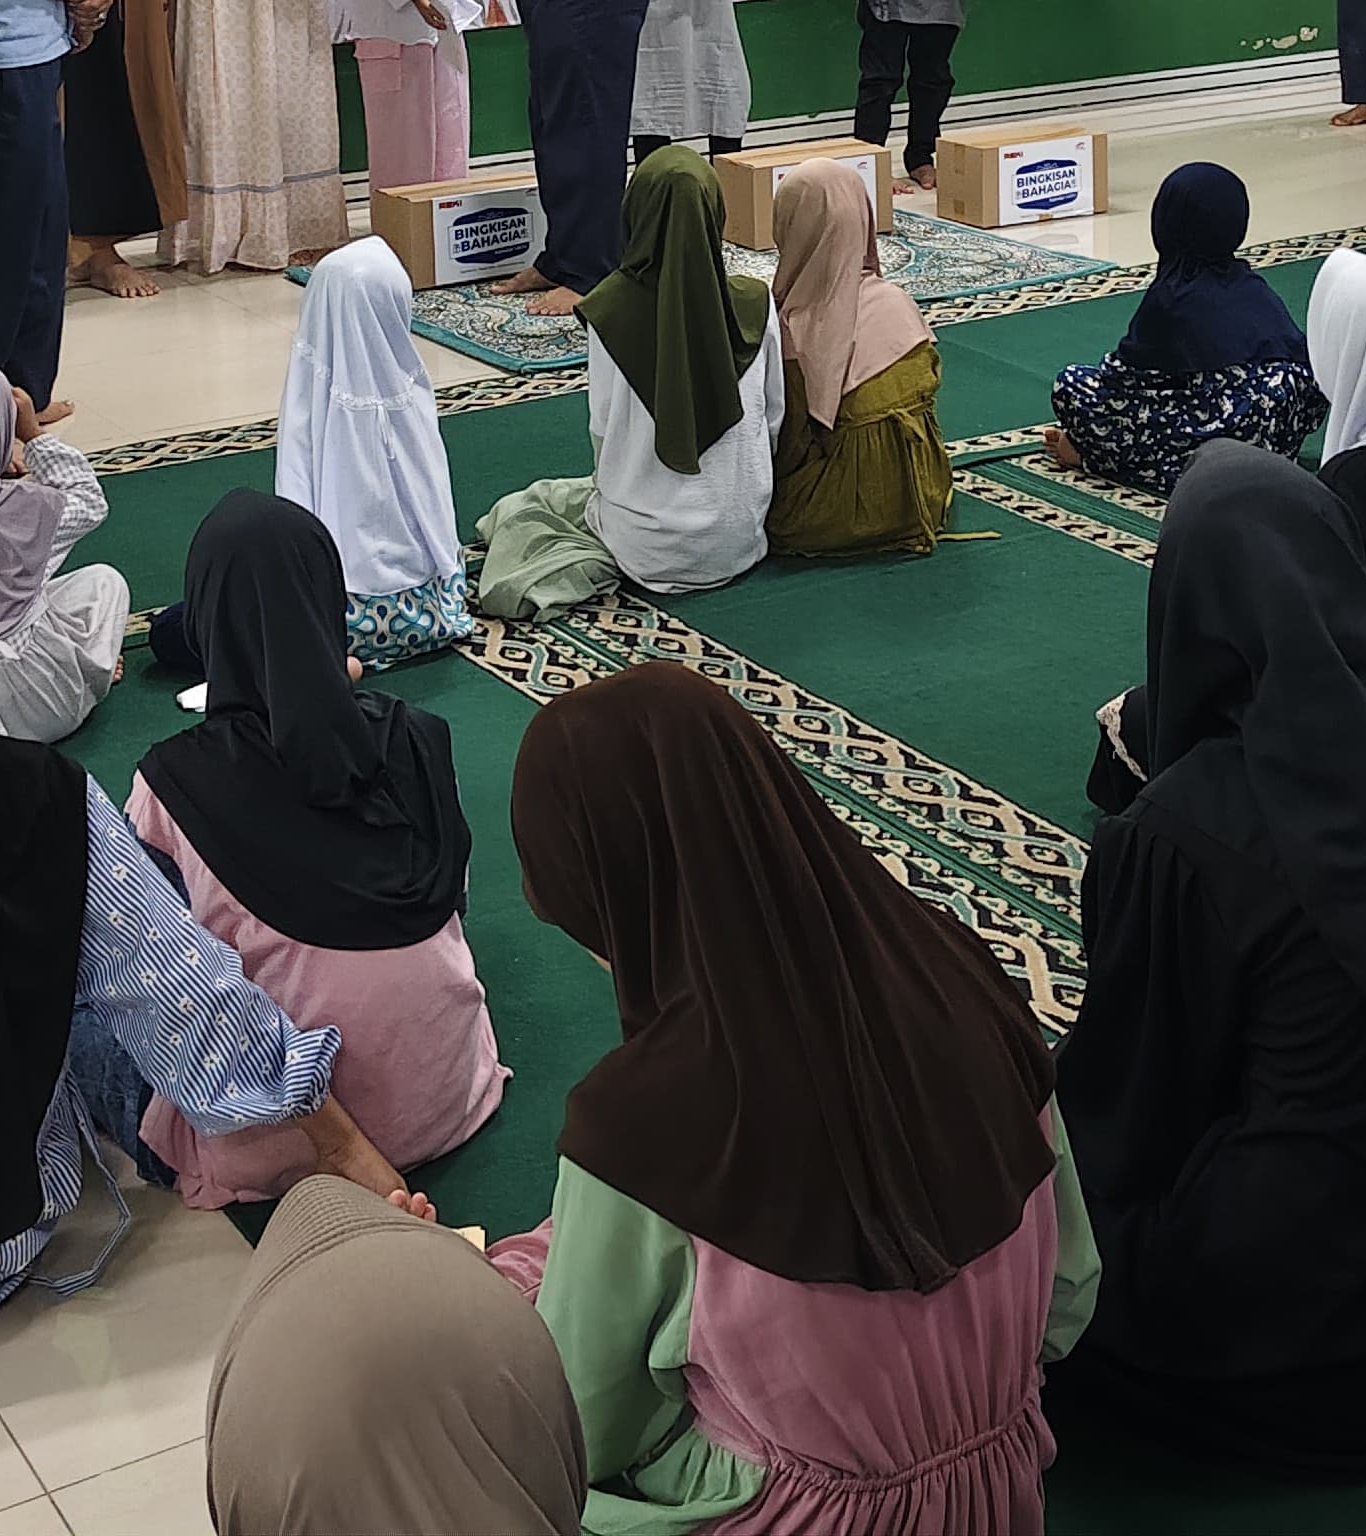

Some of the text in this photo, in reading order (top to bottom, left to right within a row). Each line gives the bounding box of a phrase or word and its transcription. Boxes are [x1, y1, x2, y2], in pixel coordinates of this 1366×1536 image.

[1017, 168, 1075, 187] BINGKISAN
[1022, 180, 1071, 199] BAHAGIA
[455, 217, 526, 241] BINGKISAN
[461, 230, 522, 252] BAHAGIA
